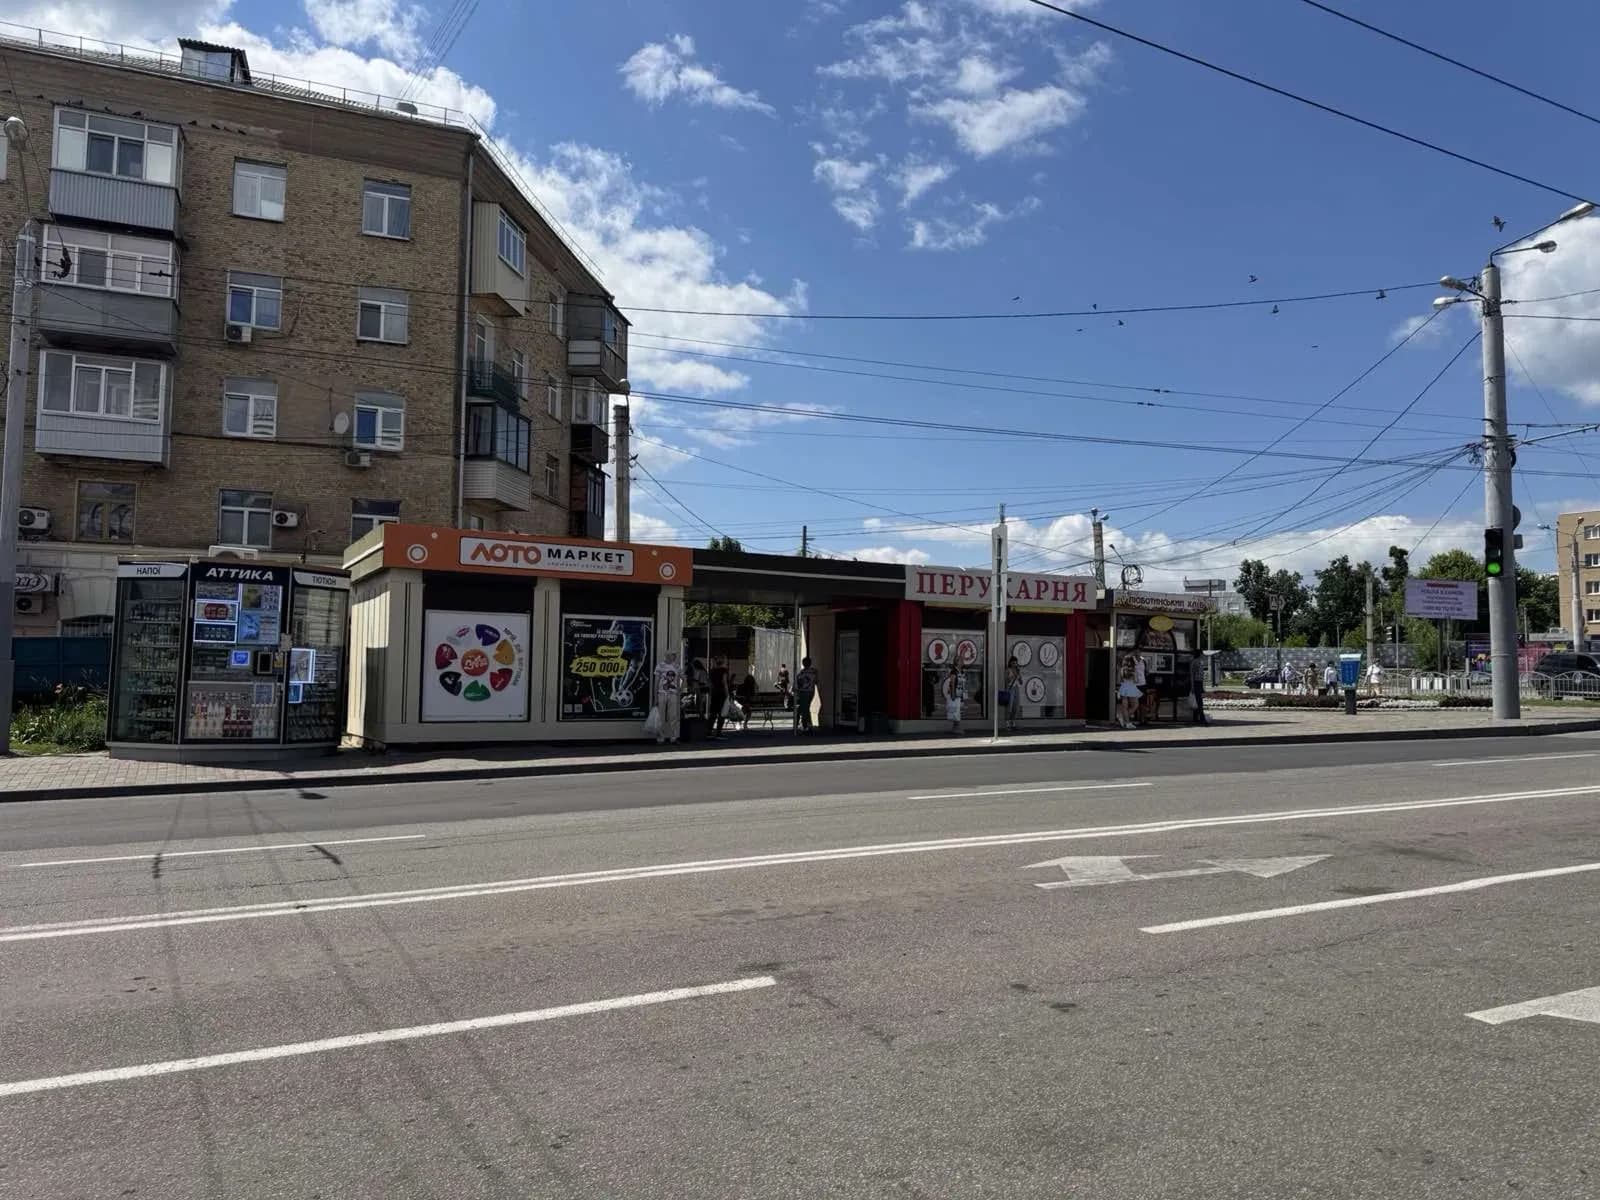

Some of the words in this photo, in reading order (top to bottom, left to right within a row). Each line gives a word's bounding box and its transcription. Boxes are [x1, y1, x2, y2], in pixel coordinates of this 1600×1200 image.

[470, 542, 541, 565] ЛОТО
[547, 548, 625, 563] МАРКЕТ
[136, 566, 161, 575] НАПОЇ
[206, 567, 273, 581] АТТИКА
[312, 575, 337, 585] ТЮТЮН
[575, 661, 597, 673] 250
